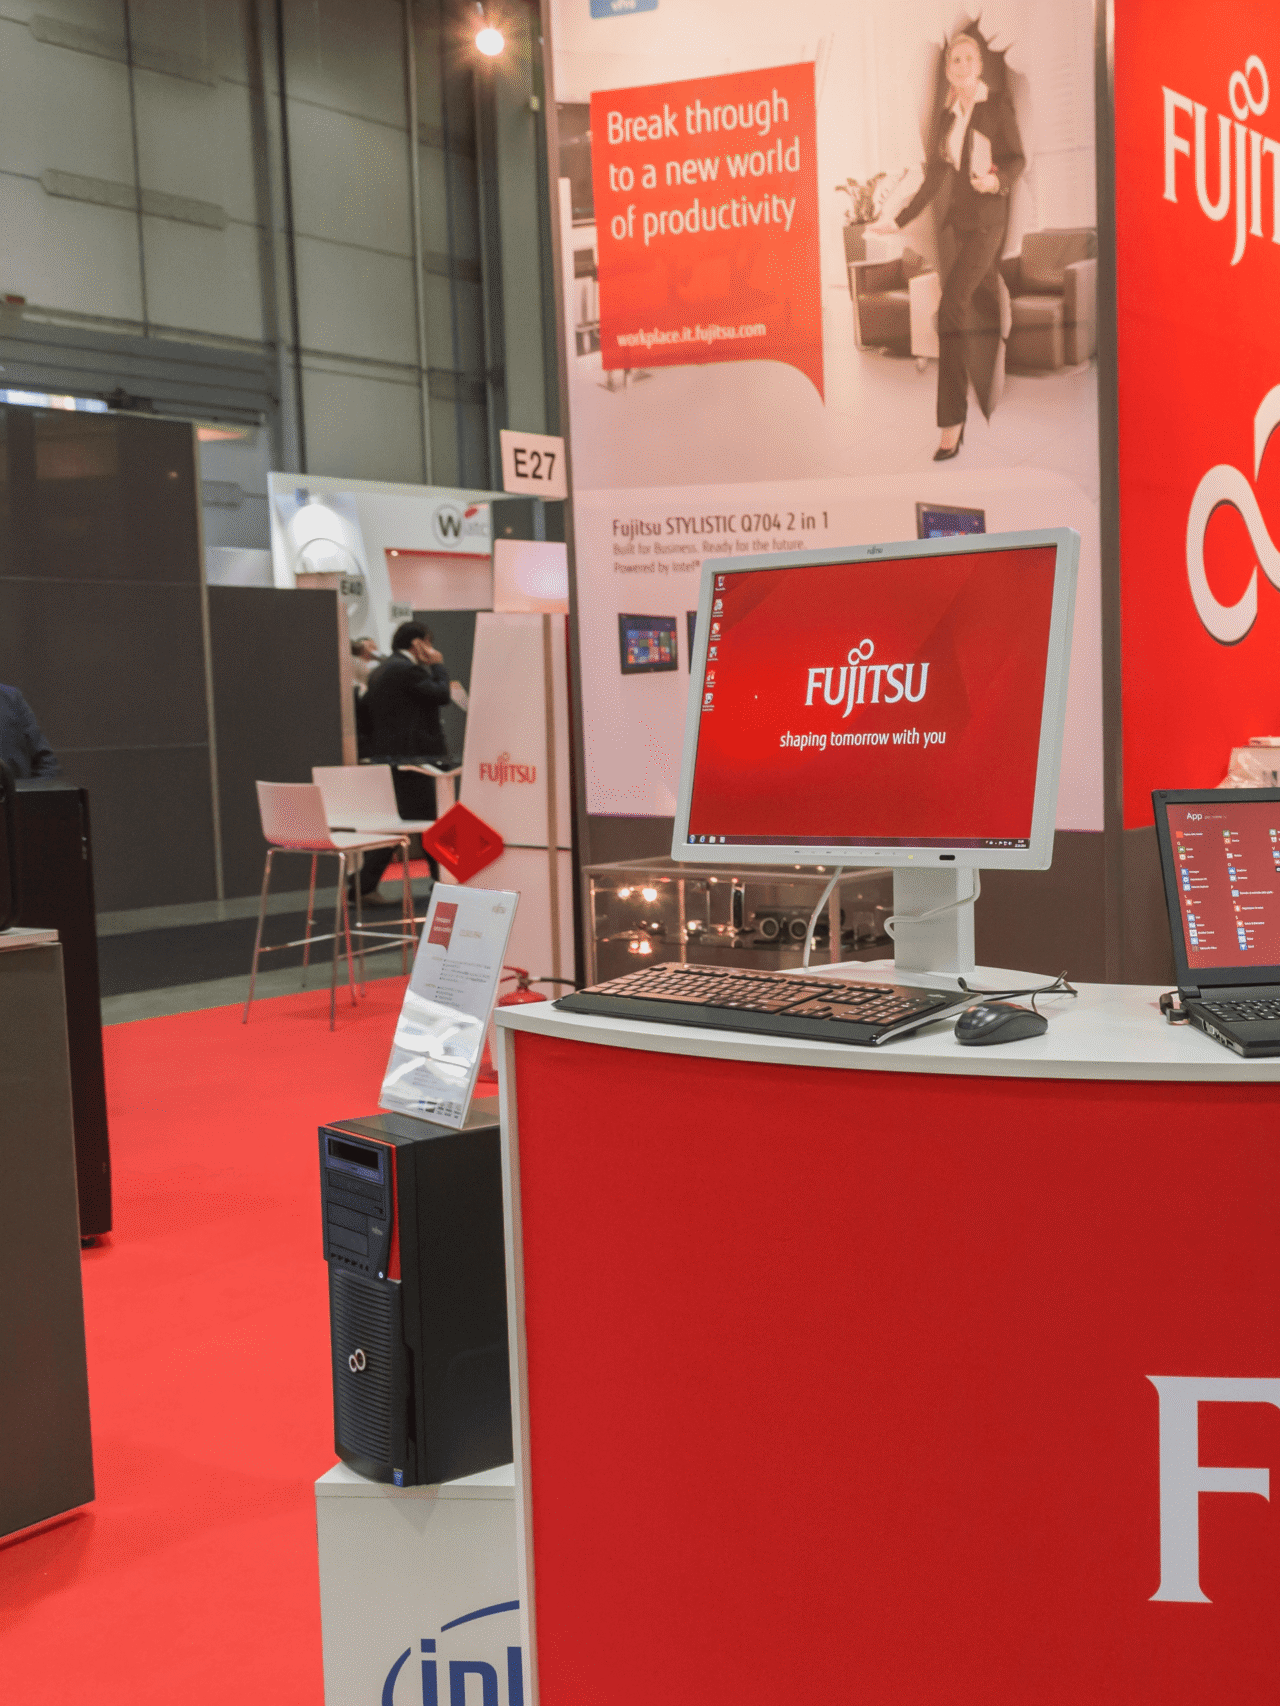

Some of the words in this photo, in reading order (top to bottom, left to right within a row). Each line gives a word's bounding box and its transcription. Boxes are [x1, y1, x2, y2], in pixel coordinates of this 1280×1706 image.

[607, 103, 680, 145] Break
[686, 87, 789, 137] through
[609, 163, 635, 192] to
[641, 163, 658, 190] a
[665, 156, 720, 186] new
[726, 136, 800, 180] world
[611, 203, 636, 240] of
[643, 193, 797, 247] productivity
[616, 323, 767, 350] workplace.it.fujitsu.com
[513, 447, 556, 481] E27
[612, 519, 662, 541] Fujitsu
[665, 514, 736, 535] STYLISTIC
[740, 513, 782, 532] Q704
[786, 512, 796, 531] 2
[800, 512, 816, 530] in
[822, 511, 829, 529] 1
[612, 542, 635, 556] Built
[639, 542, 651, 555] for
[701, 540, 732, 556] Ready
[735, 539, 749, 551] for
[752, 539, 769, 551] the
[613, 562, 655, 574] Powered
[658, 560, 669, 575] by
[804, 662, 931, 719] FUJITSU
[779, 730, 828, 752] shaping
[830, 731, 890, 746] tomorrow
[892, 727, 920, 745] with
[923, 731, 947, 749] you
[479, 761, 537, 788] FUJITSU
[1186, 812, 1203, 821] App
